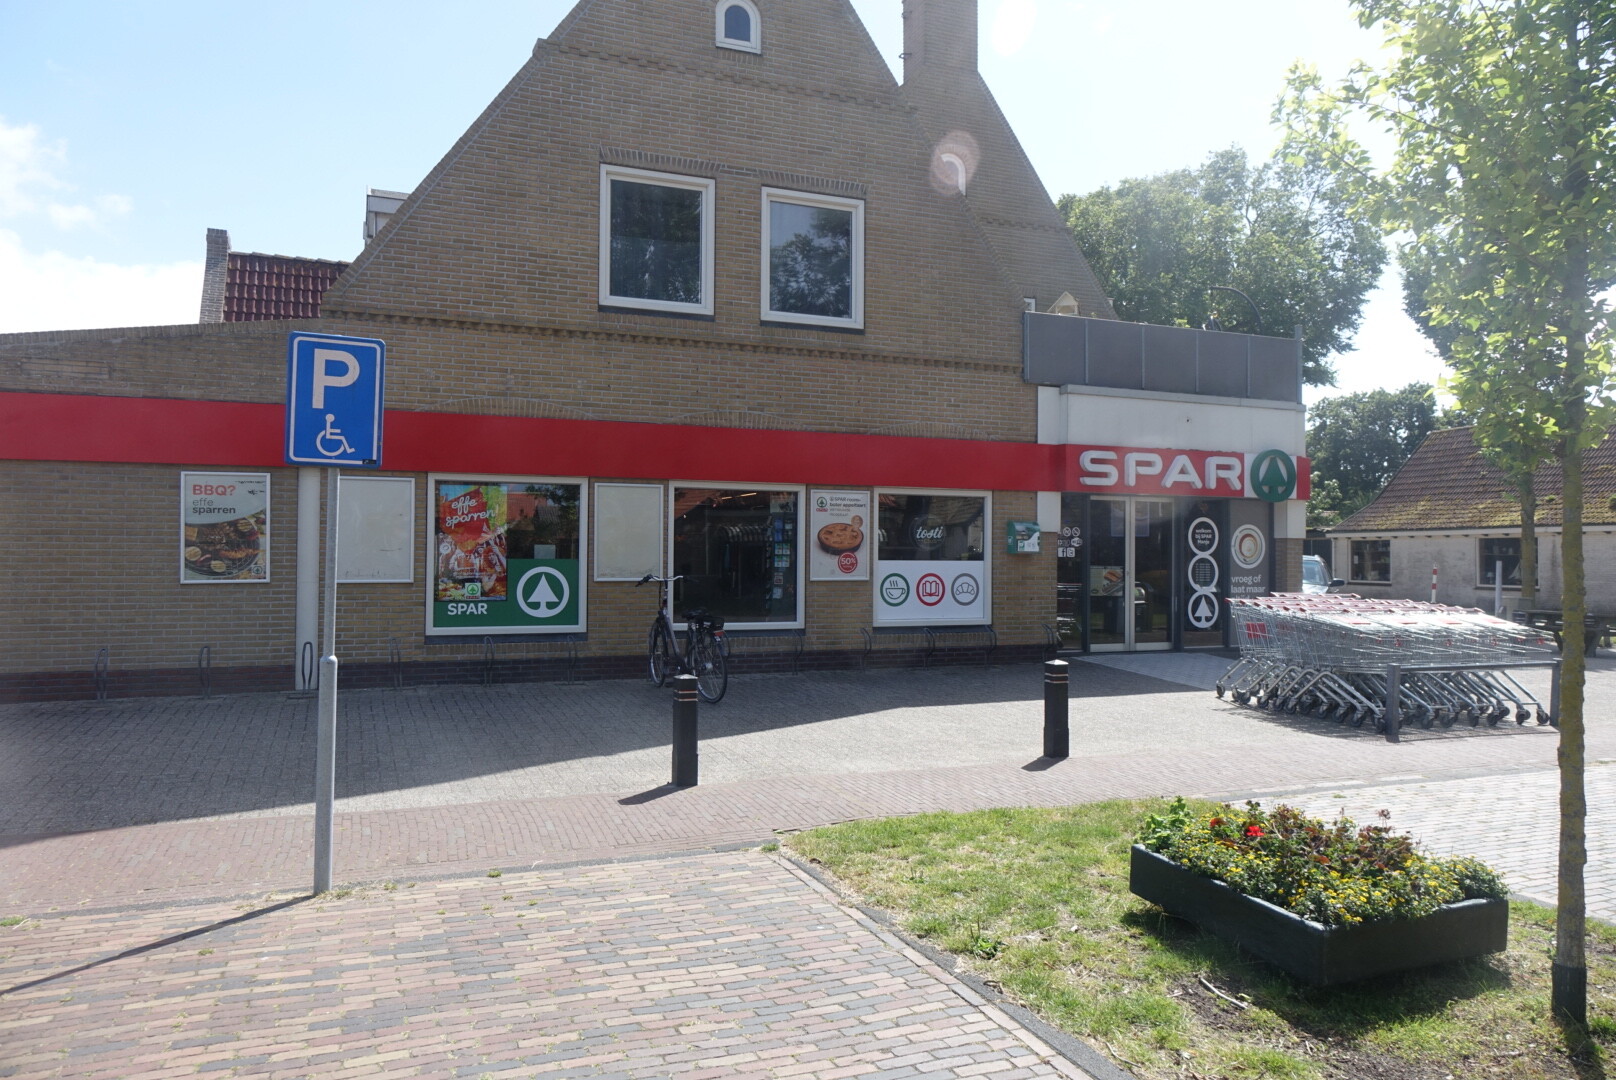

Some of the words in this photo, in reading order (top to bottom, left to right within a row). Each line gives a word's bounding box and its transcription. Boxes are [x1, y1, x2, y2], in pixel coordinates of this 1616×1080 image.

[312, 348, 360, 409] P
[1079, 450, 1242, 490] SPAR
[192, 484, 236, 496] BBQ?
[192, 498, 214, 506] effe
[451, 495, 478, 515] effe
[192, 506, 236, 515] sparren
[916, 526, 944, 539] tosti
[841, 557, 856, 565] 50%
[1231, 576, 1253, 585] vroeg
[1253, 574, 1262, 583] of
[1230, 585, 1245, 593] laat
[447, 602, 488, 615] SPAR
